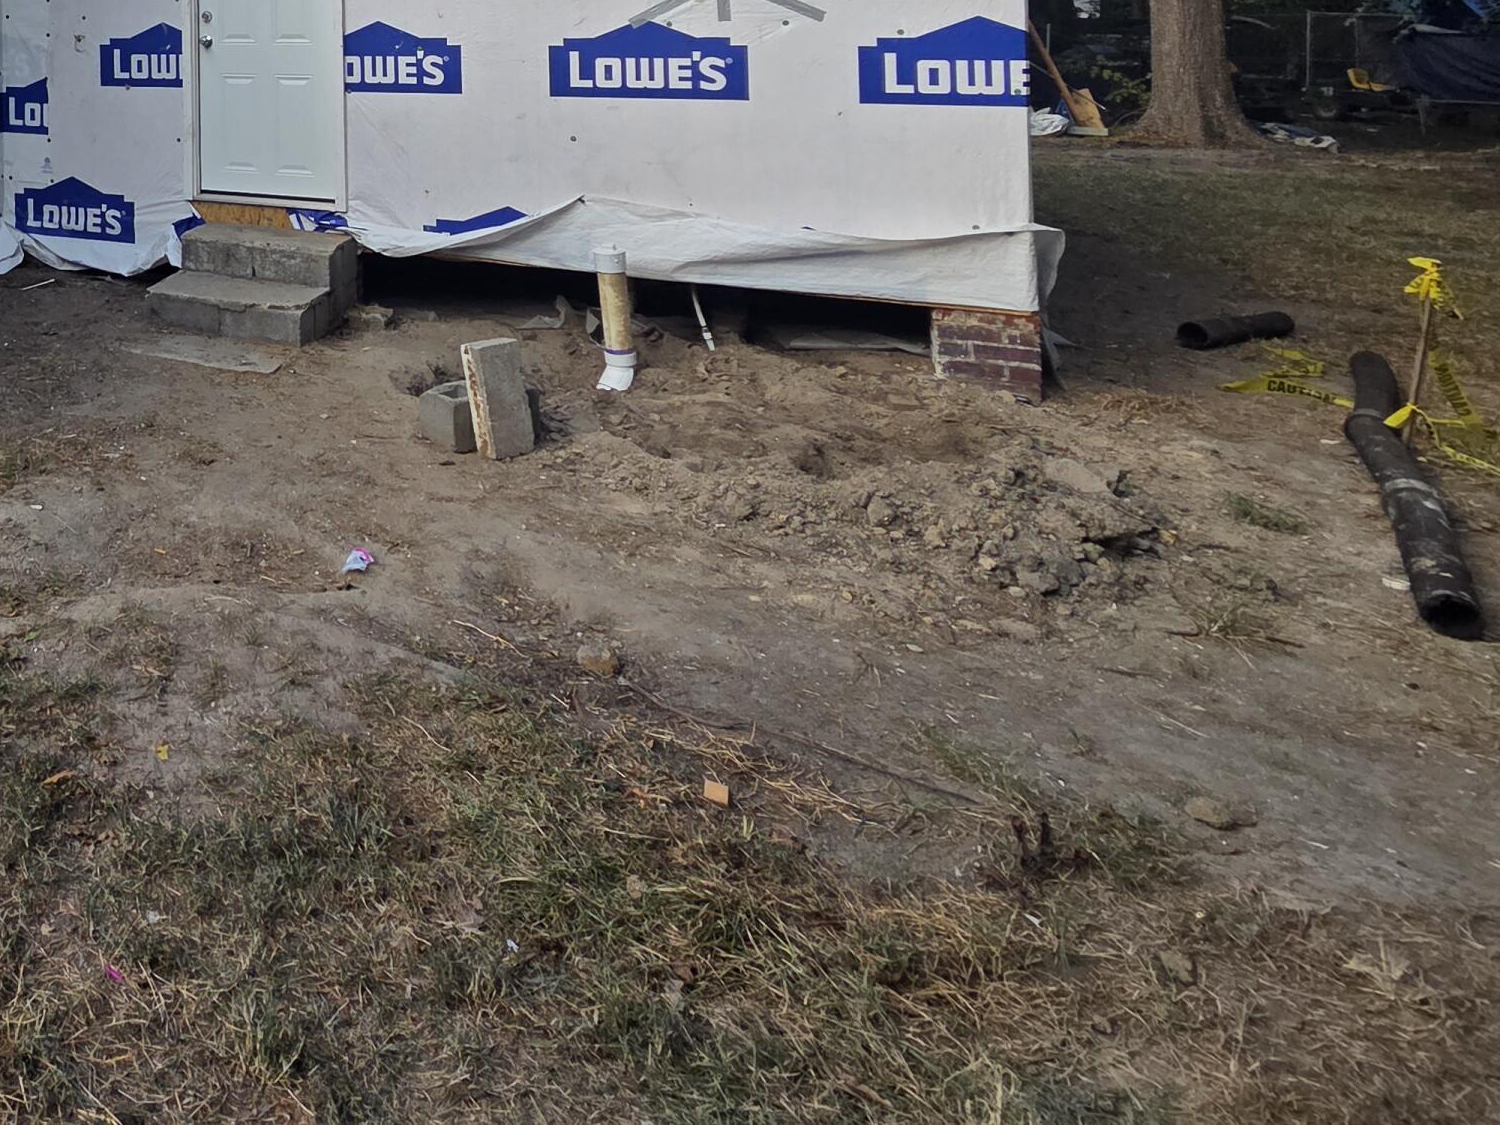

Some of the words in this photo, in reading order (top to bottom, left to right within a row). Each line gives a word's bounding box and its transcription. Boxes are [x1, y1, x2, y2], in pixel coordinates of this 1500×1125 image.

[113, 48, 183, 80] LOW
[568, 51, 726, 91] LOWE'S
[26, 201, 122, 237] LOWE'S
